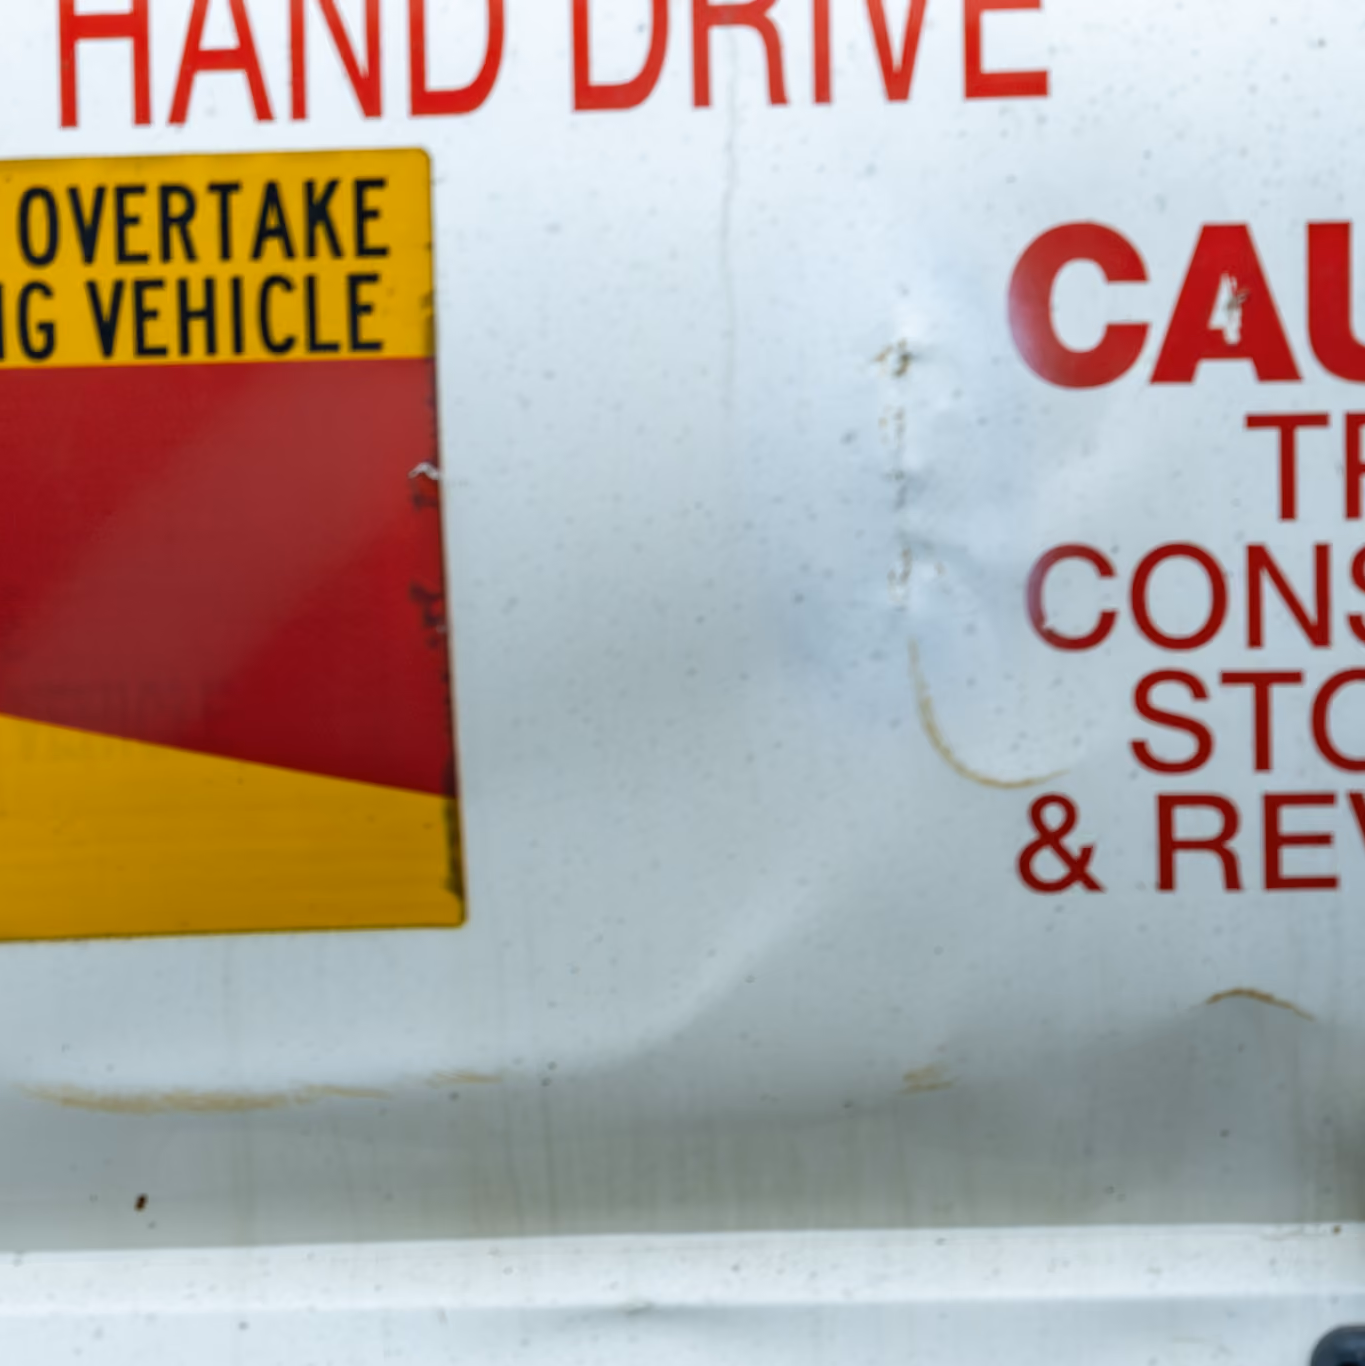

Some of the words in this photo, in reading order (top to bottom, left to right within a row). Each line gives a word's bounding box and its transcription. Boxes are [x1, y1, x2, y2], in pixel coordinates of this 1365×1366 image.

[57, 0, 505, 129] HAND
[570, 0, 1050, 113] DRIVE
[18, 178, 390, 269] OVERTAKE
[86, 273, 384, 359] VEHICLE
[1246, 412, 1365, 520] T
[1027, 543, 1365, 651] CON
[1017, 793, 1103, 894] &
[1156, 791, 1365, 891] RE
